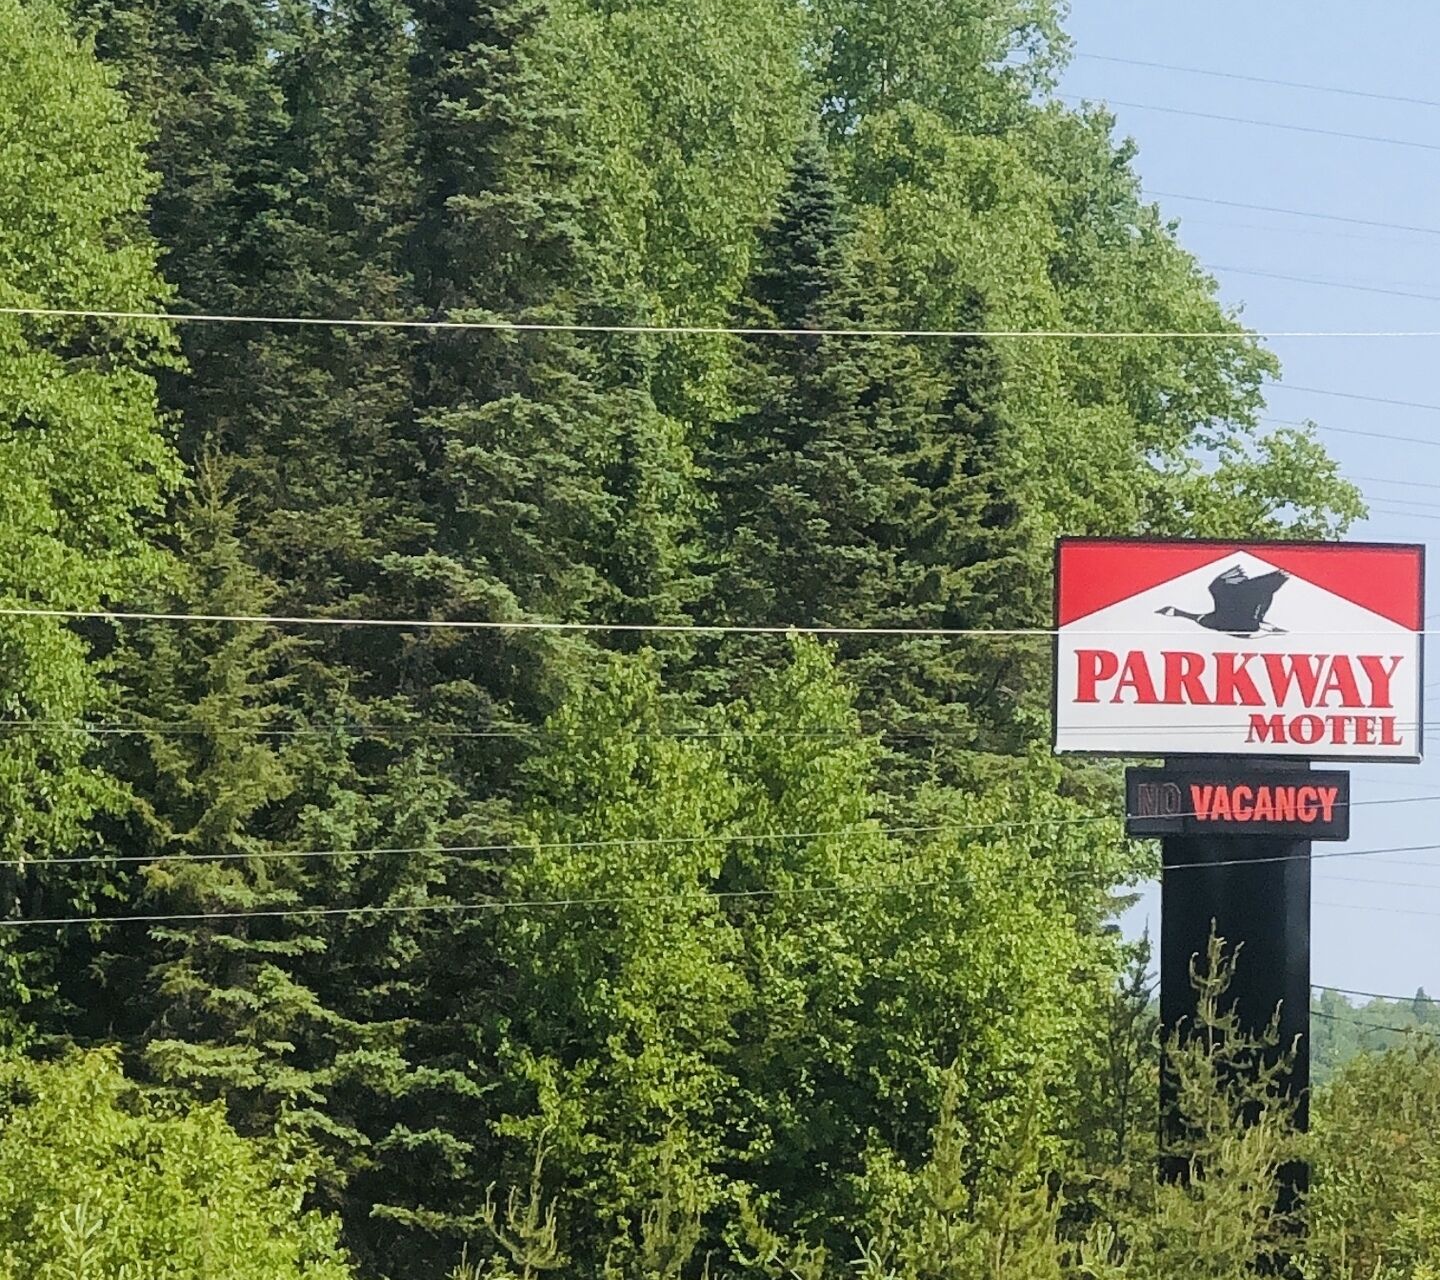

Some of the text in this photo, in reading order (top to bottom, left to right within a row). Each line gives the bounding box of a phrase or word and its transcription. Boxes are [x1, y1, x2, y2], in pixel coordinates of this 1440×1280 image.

[1072, 649, 1404, 708] PARKWAY
[1244, 713, 1404, 746] MOTEL
[1137, 782, 1338, 822] NO VACANCY
